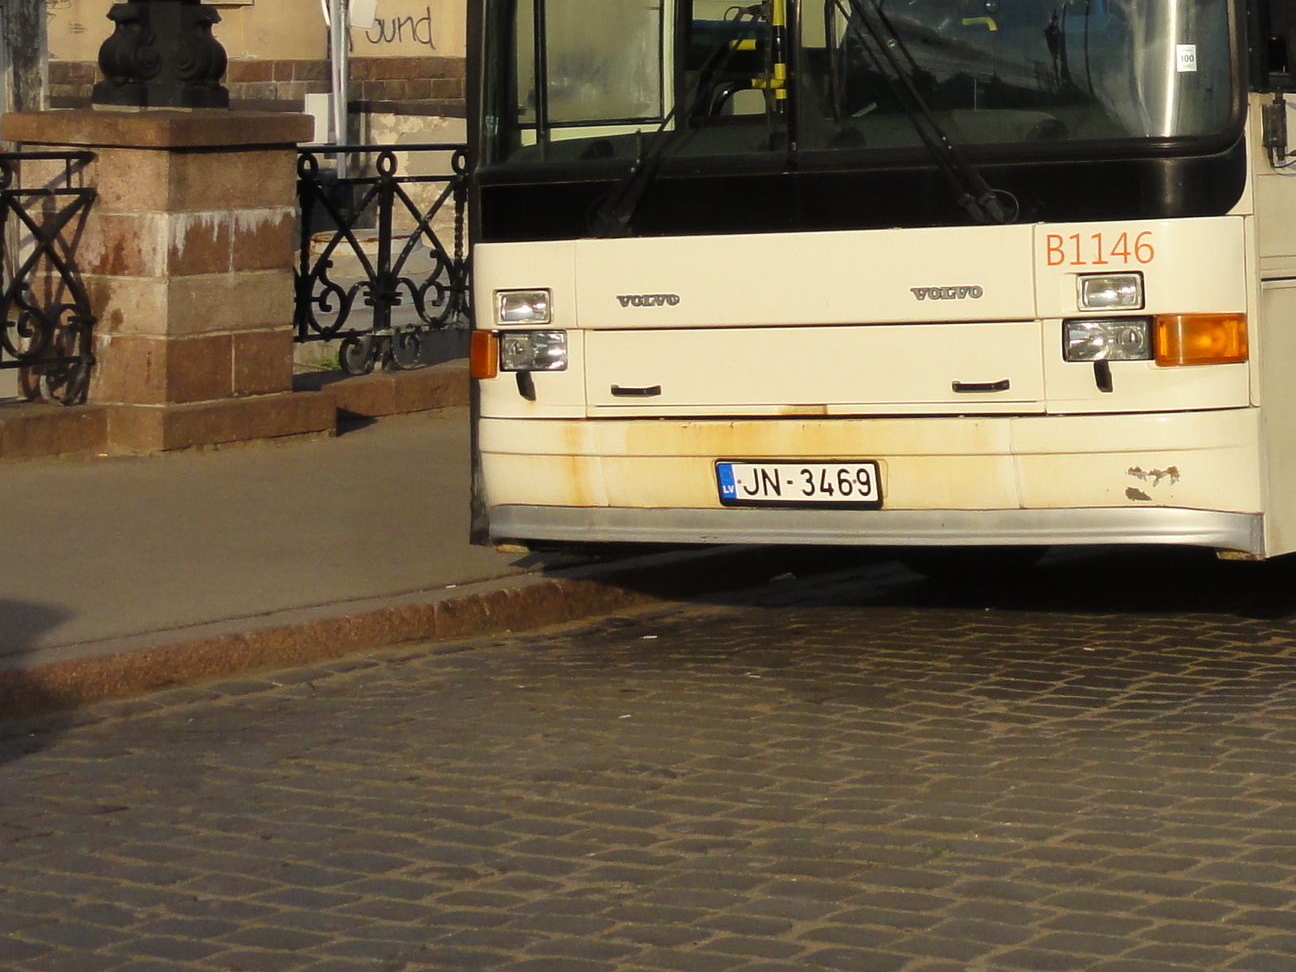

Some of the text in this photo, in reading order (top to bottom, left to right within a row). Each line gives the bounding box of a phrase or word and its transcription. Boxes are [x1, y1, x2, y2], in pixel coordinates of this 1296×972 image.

[1181, 54, 1195, 63] 100
[1047, 231, 1155, 266] B1146
[616, 293, 680, 308] VOLVO
[909, 285, 983, 301] VOLVO
[723, 485, 735, 493] LV
